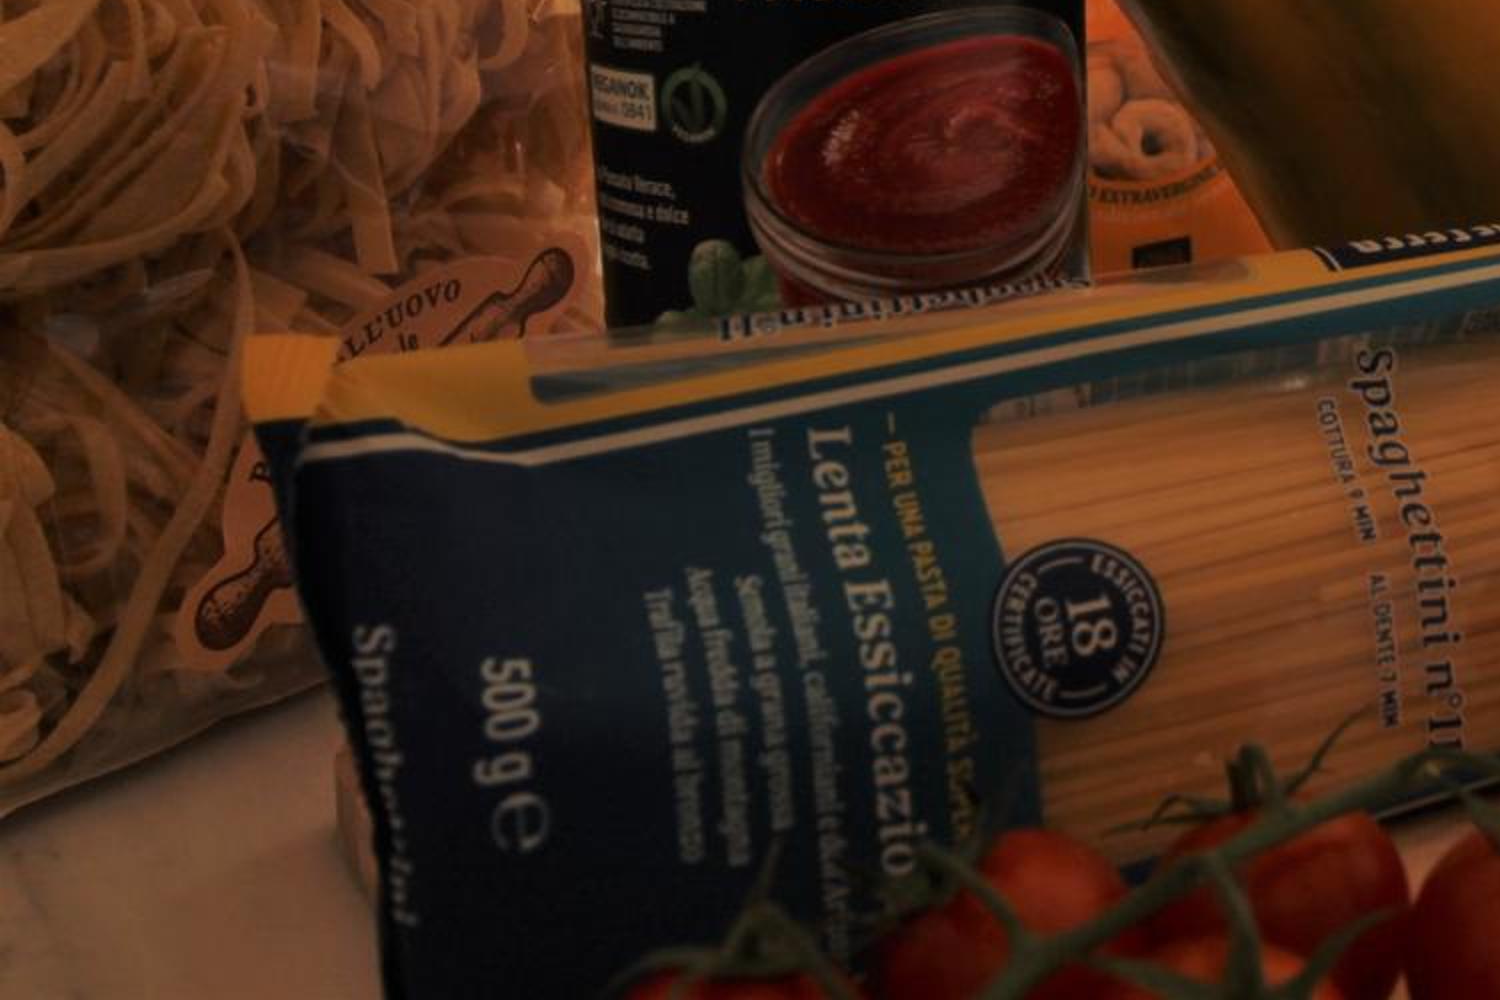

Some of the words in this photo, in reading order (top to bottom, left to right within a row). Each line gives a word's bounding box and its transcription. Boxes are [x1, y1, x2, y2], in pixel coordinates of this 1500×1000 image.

[746, 440, 793, 530] migliori
[881, 440, 914, 488] PER
[1317, 400, 1356, 483] COTTURA
[1354, 504, 1378, 542] MIN
[1351, 350, 1462, 647] Spaghettini
[893, 492, 925, 539] UNA
[760, 531, 809, 581] grani
[907, 540, 949, 610] PASTA
[1370, 575, 1388, 599] AL
[645, 587, 687, 661] Trafila
[684, 568, 722, 627] Acqua
[734, 573, 777, 651] Semola
[928, 613, 960, 642] DI
[1034, 596, 1072, 667] ORE
[1065, 592, 1121, 658] 18
[1088, 554, 1151, 656] ESSICCATI
[1374, 603, 1397, 665] DENTE
[702, 629, 741, 707] fredda
[806, 424, 873, 570] Lenta
[843, 579, 930, 877] Essiccazio
[1112, 657, 1140, 682] IN
[479, 656, 542, 743] 500
[660, 661, 700, 743] ruvida
[716, 709, 749, 736] di
[750, 670, 790, 746] grana
[930, 647, 981, 754] QUALITÀ
[1379, 690, 1400, 728] MIN
[471, 749, 536, 787] g
[672, 747, 705, 770] al
[803, 671, 847, 814] californiani
[673, 773, 706, 864] bronzo
[717, 739, 753, 867] montagna
[755, 750, 797, 829] grossa
